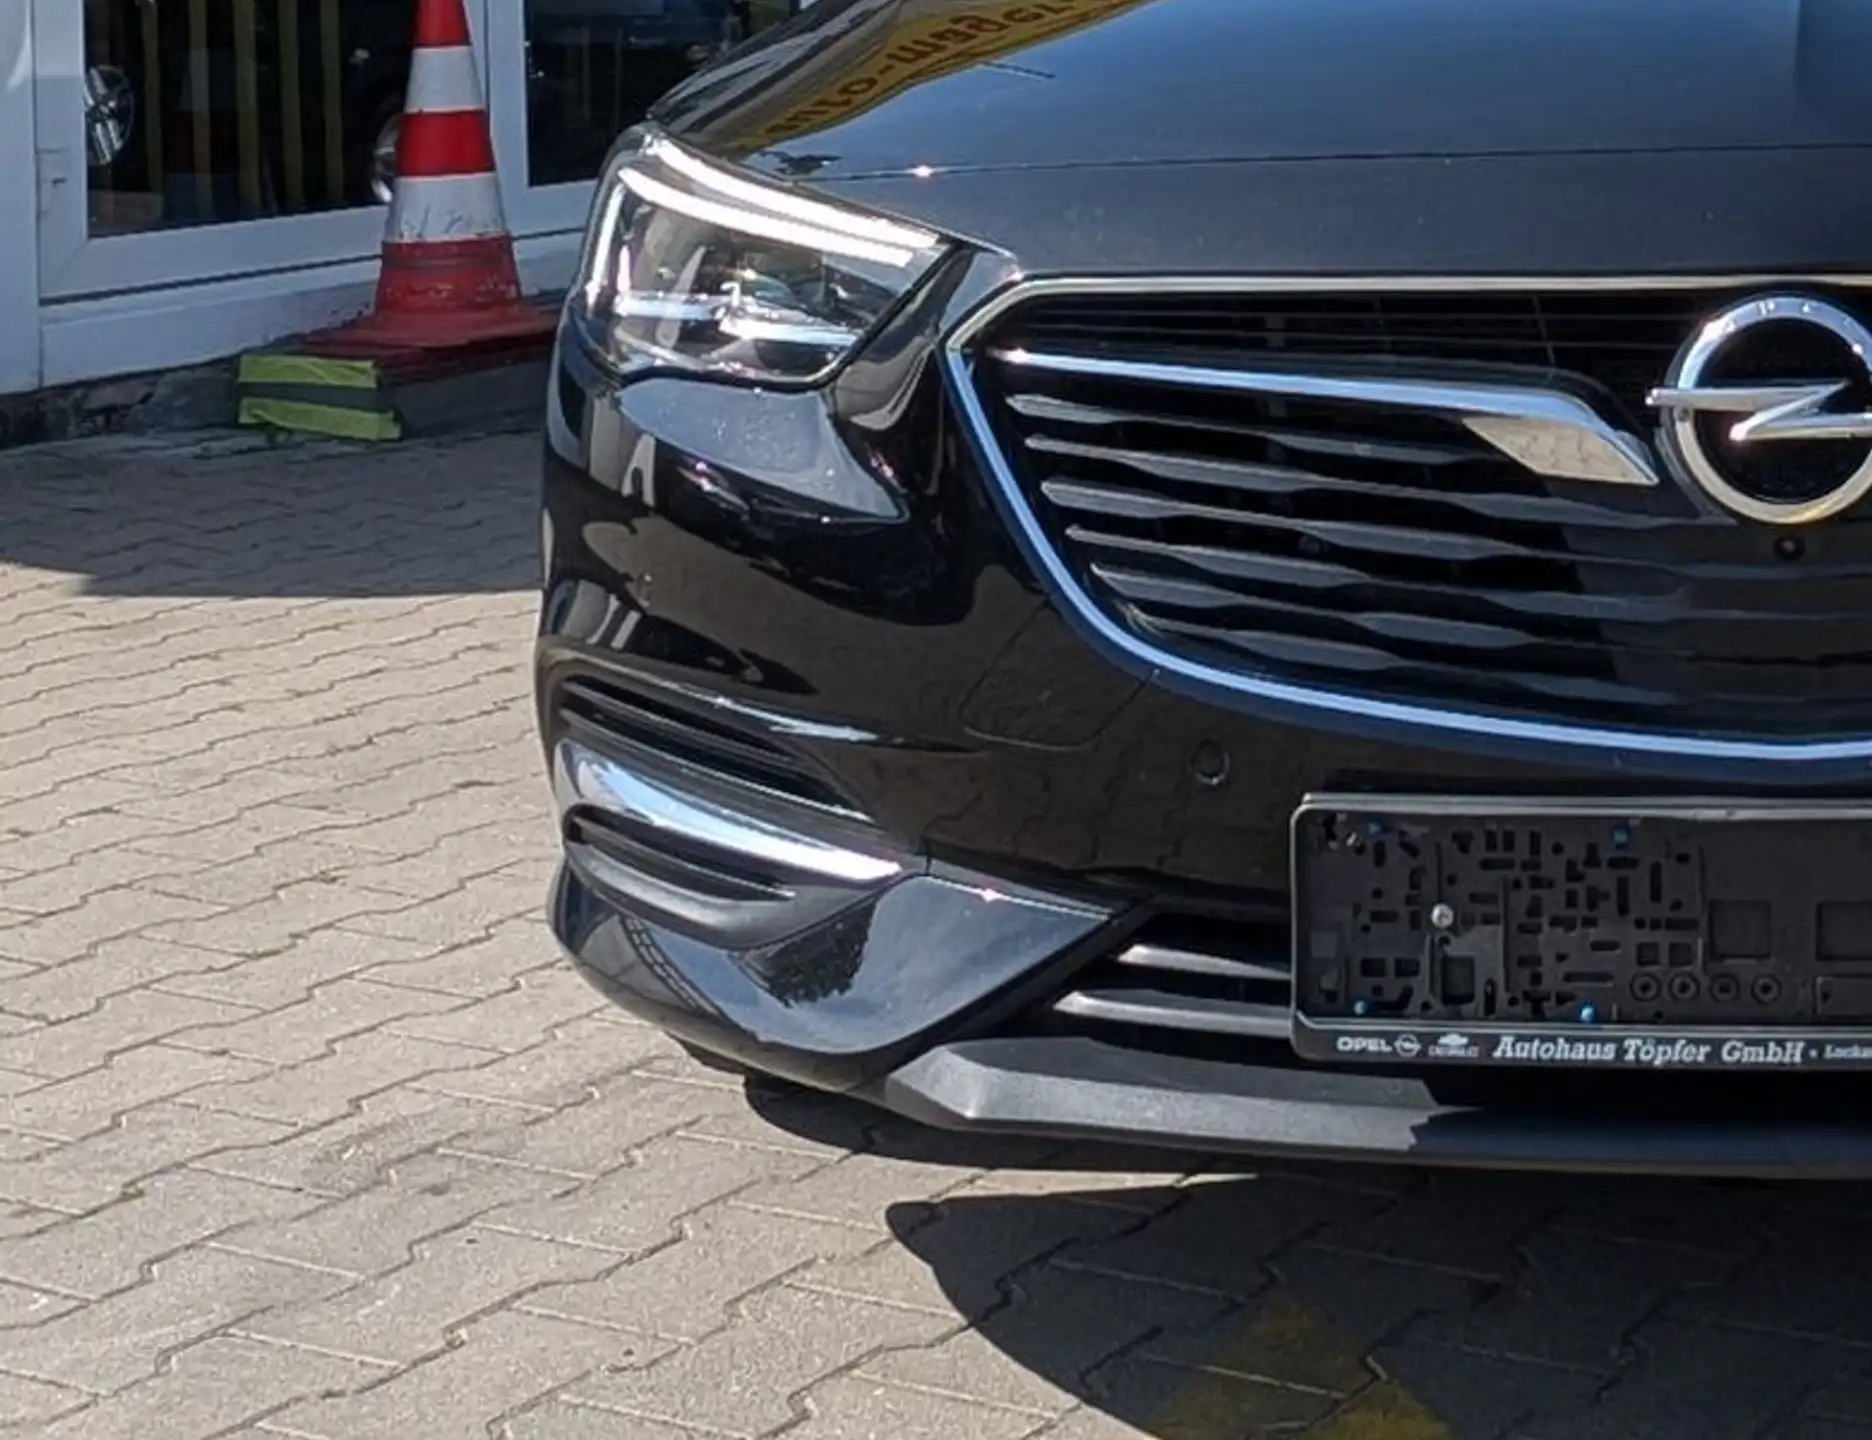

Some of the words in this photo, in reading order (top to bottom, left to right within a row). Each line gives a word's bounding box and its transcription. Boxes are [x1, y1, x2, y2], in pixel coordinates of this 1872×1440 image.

[1336, 1035, 1394, 1053] OPEL
[1492, 1034, 1618, 1061] Autohaus
[1622, 1036, 1711, 1067] Töpfer
[1721, 1039, 1806, 1064] GmbH
